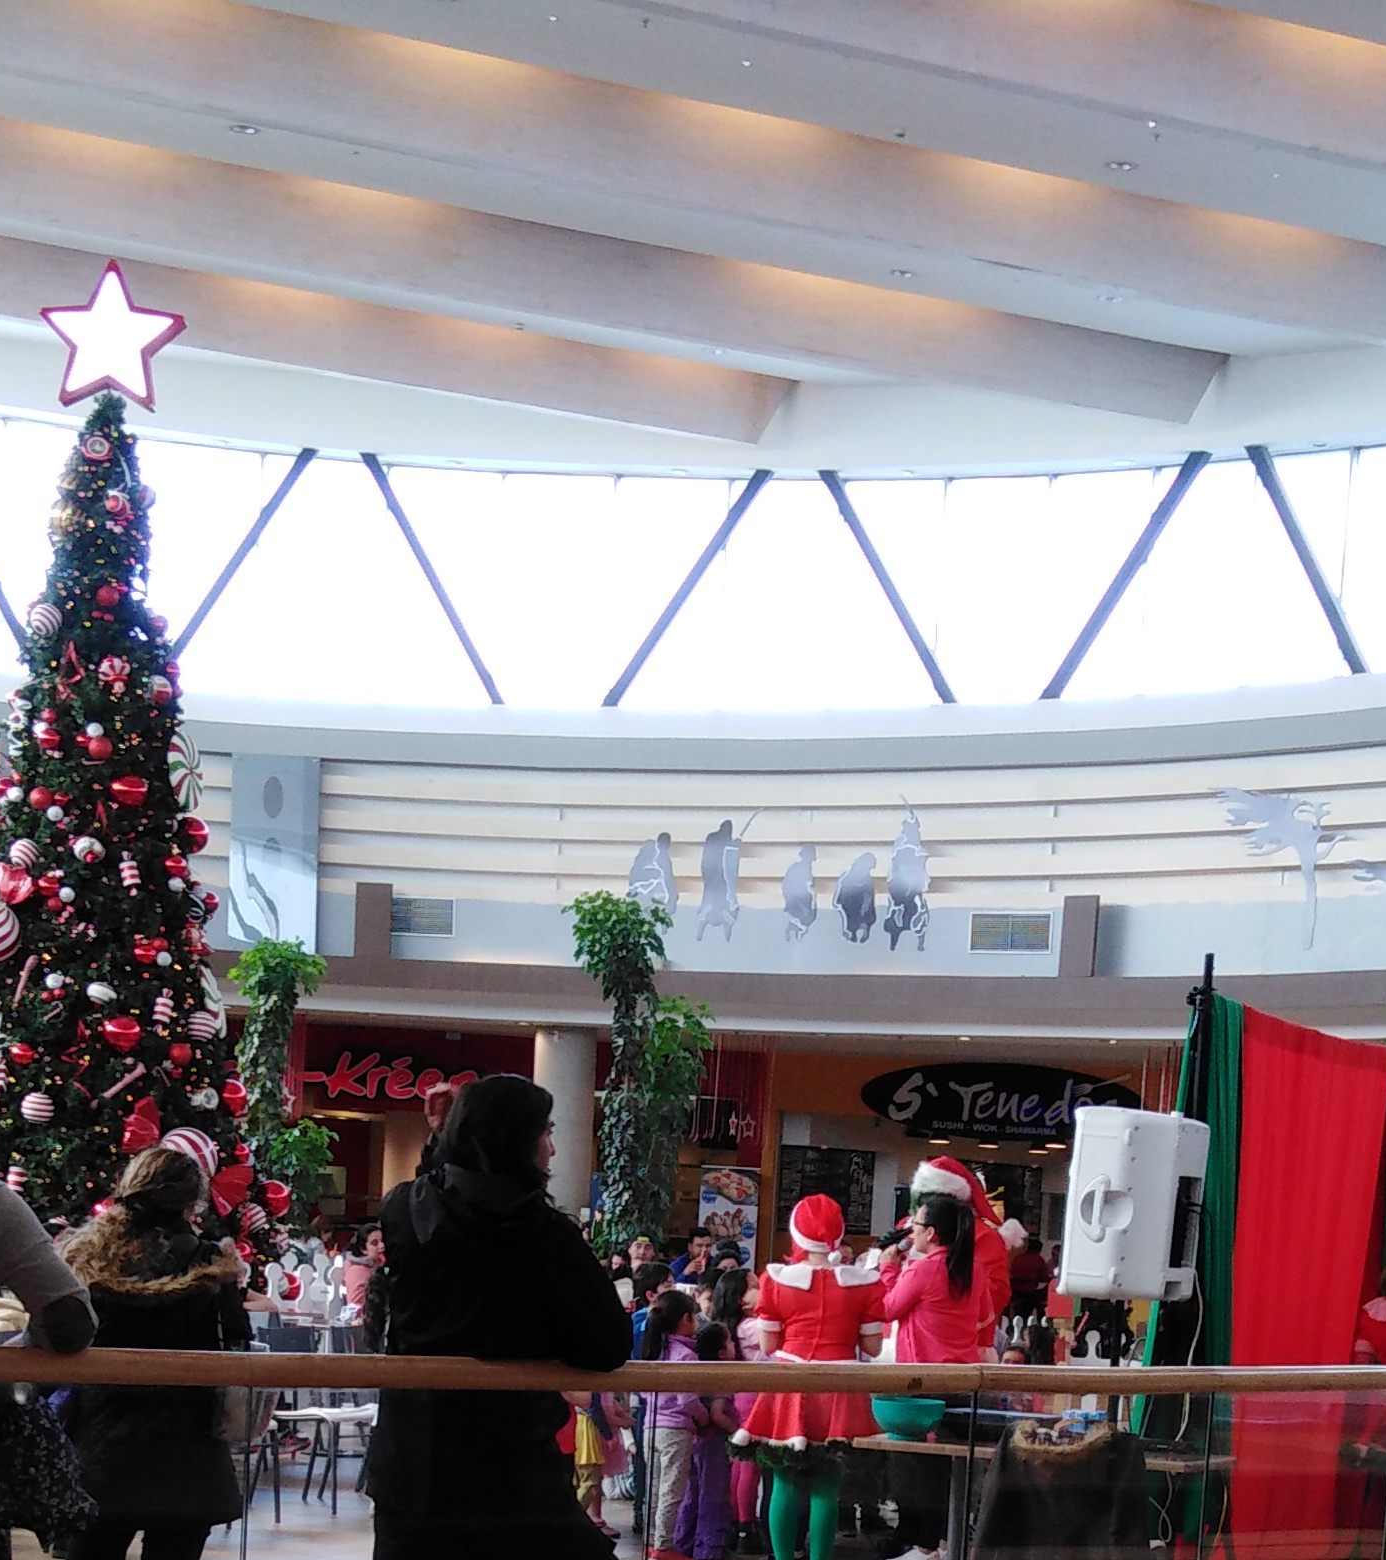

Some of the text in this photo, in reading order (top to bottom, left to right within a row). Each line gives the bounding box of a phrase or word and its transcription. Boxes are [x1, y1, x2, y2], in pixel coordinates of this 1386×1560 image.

[931, 1119, 964, 1131] SUSHI
[972, 1122, 999, 1133] WOK
[1004, 1126, 1057, 1136] SHAWARMA
